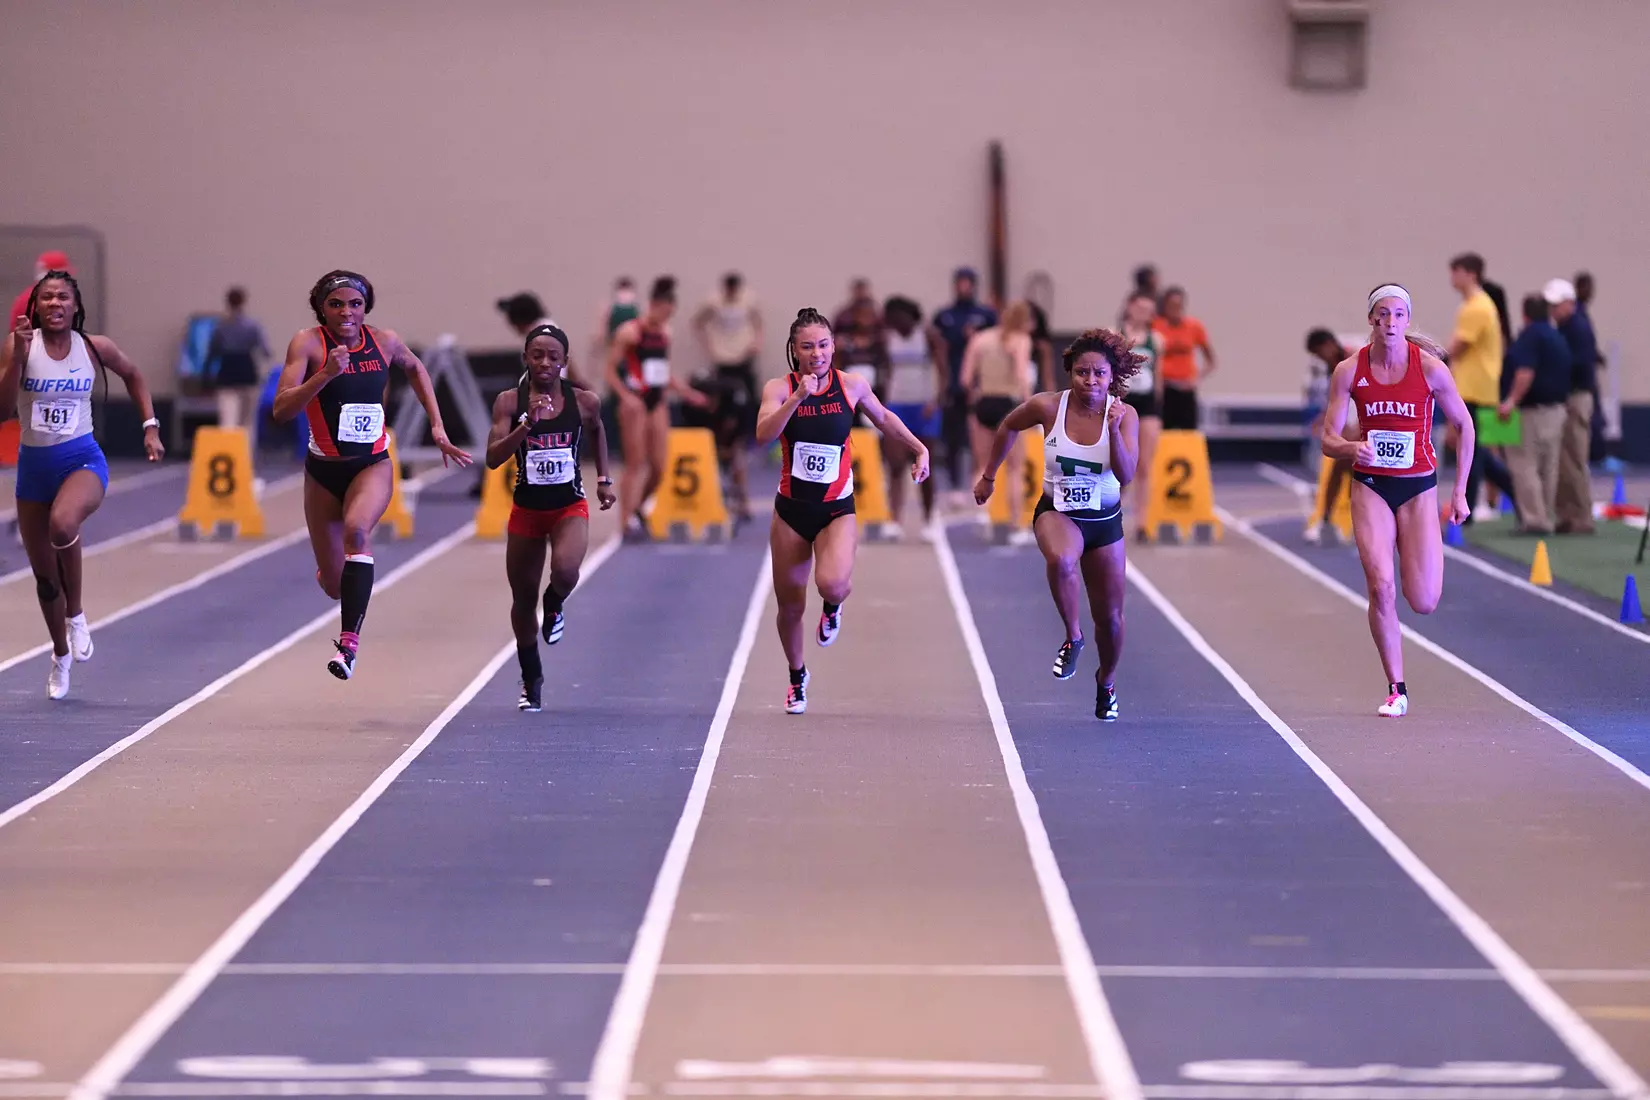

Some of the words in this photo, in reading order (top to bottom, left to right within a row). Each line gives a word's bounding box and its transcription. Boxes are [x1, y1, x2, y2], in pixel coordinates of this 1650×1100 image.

[359, 359, 382, 372] STATE
[23, 378, 92, 392] BUFFALO
[43, 408, 68, 424] 161
[797, 405, 818, 417] BALL
[820, 402, 842, 415] STATE
[1365, 401, 1416, 418] MIAMI
[354, 415, 371, 432] 52
[527, 432, 573, 449] NIU
[1377, 441, 1405, 458] 352
[536, 460, 563, 475] 401
[806, 455, 826, 472] 63
[208, 454, 235, 497] 8
[674, 455, 700, 497] 5
[1165, 458, 1193, 500] 2
[1063, 487, 1091, 503] 255
